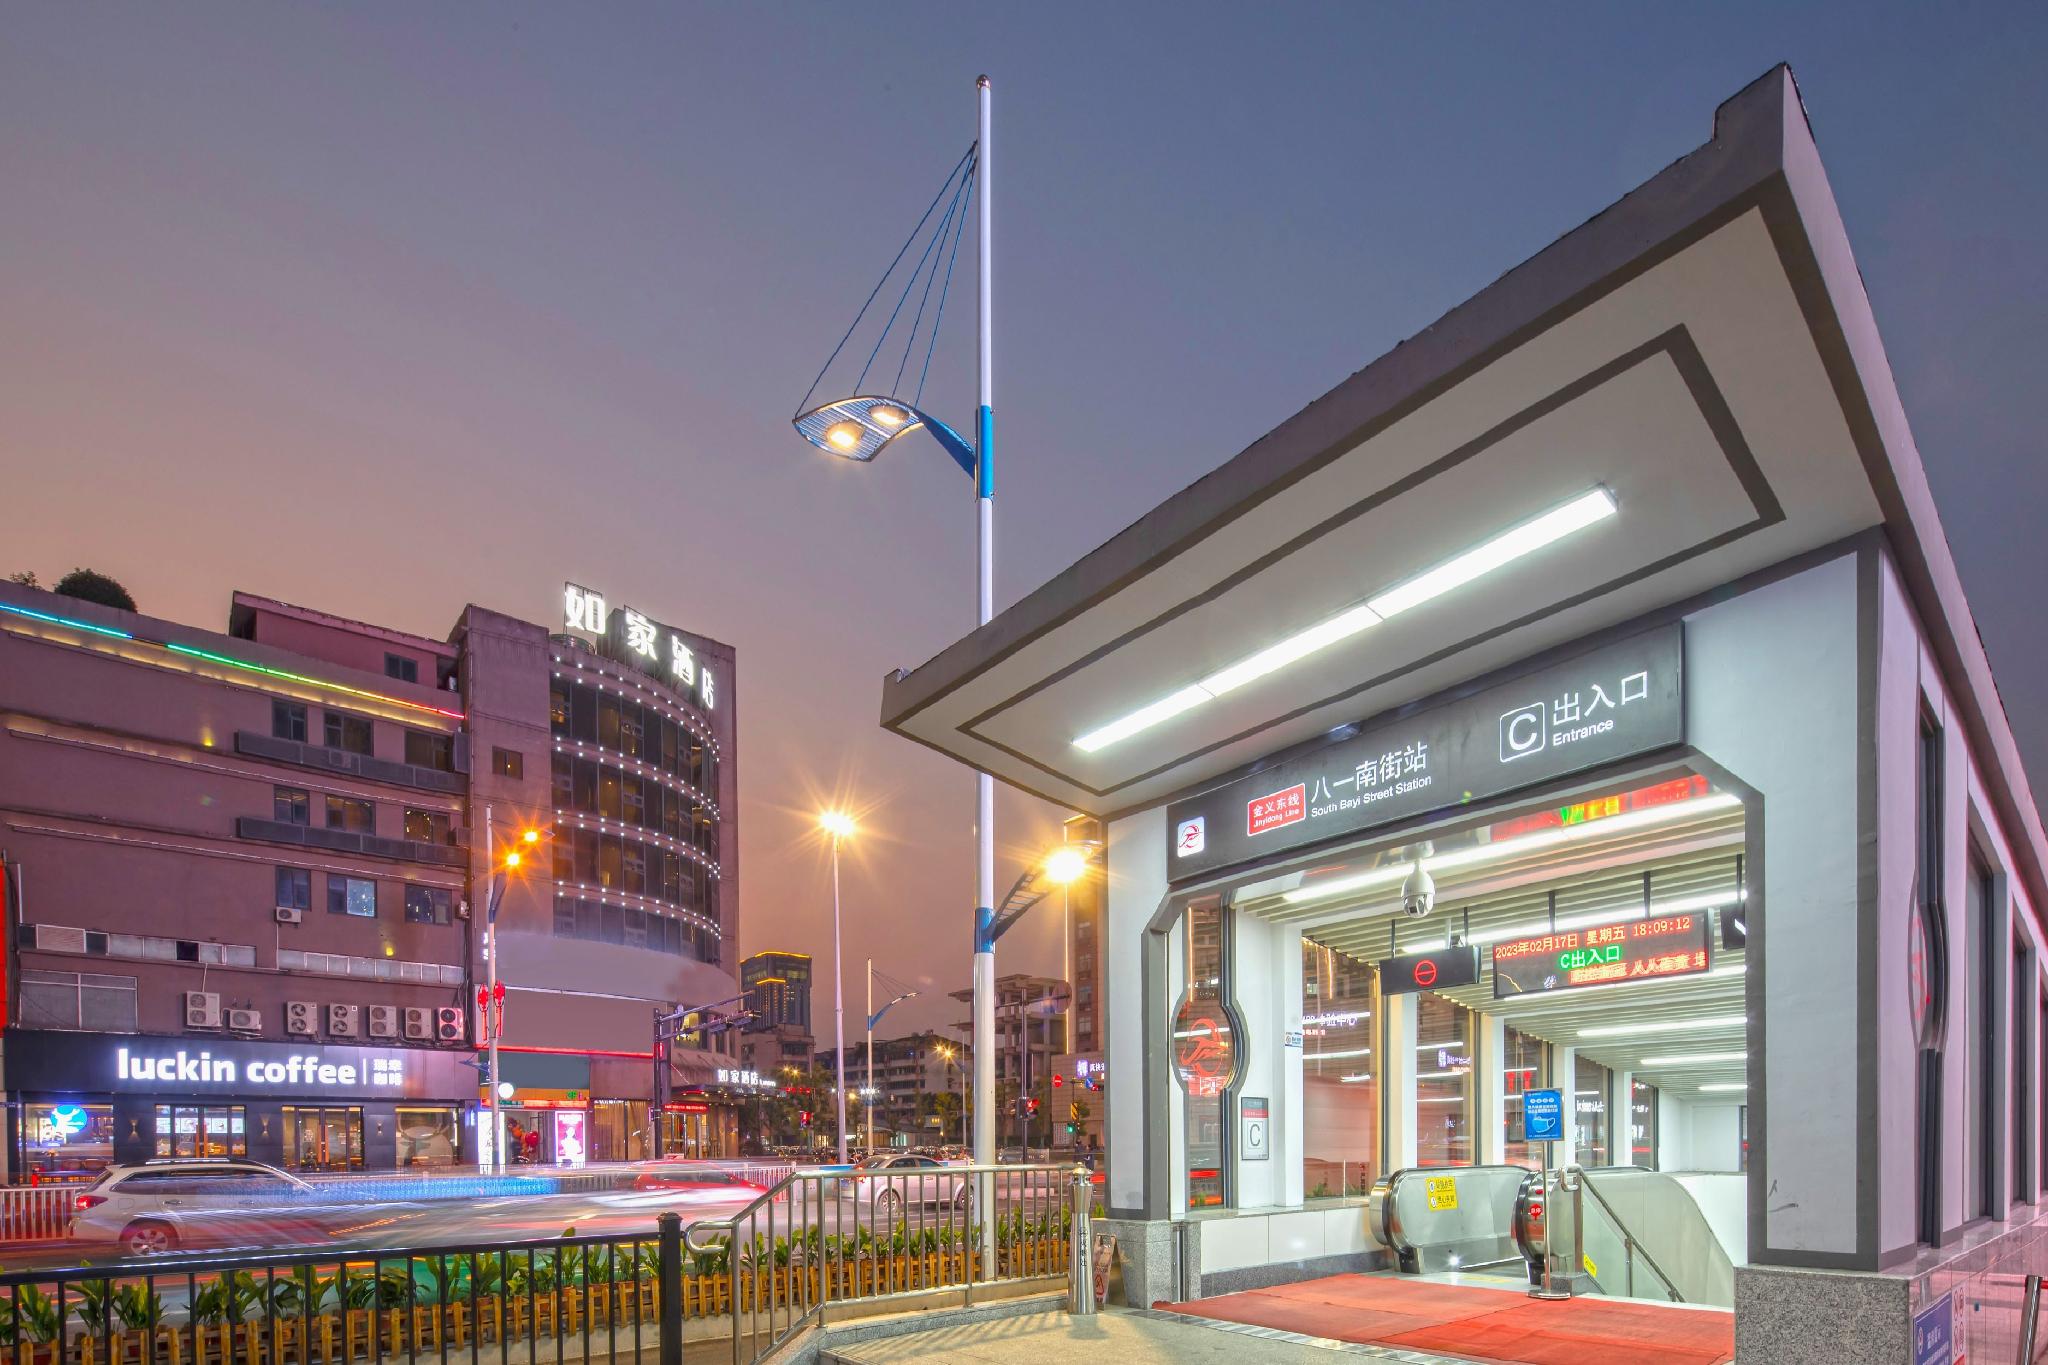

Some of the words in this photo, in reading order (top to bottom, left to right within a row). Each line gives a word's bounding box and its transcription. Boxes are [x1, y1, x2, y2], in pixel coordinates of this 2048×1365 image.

[1553, 671, 1648, 726] 出入口
[1509, 713, 1537, 750] C
[1553, 719, 1614, 746] Entrance
[1311, 741, 1428, 804] 八一南街站
[1253, 792, 1300, 818] 金义东线
[1311, 804, 1338, 818] South
[1340, 795, 1361, 812] Bayi
[1363, 785, 1394, 804] Street
[1395, 775, 1432, 795] Station
[1496, 934, 1579, 959] 2023年02月17日
[1587, 926, 1626, 944] 星期五
[1633, 917, 1691, 937] 18:09:12
[1559, 945, 1621, 969] C出入口
[118, 1048, 236, 1082] luckin
[246, 1055, 356, 1084] coffee
[717, 1068, 759, 1086] 如家酒店
[1250, 1123, 1261, 1147] C
